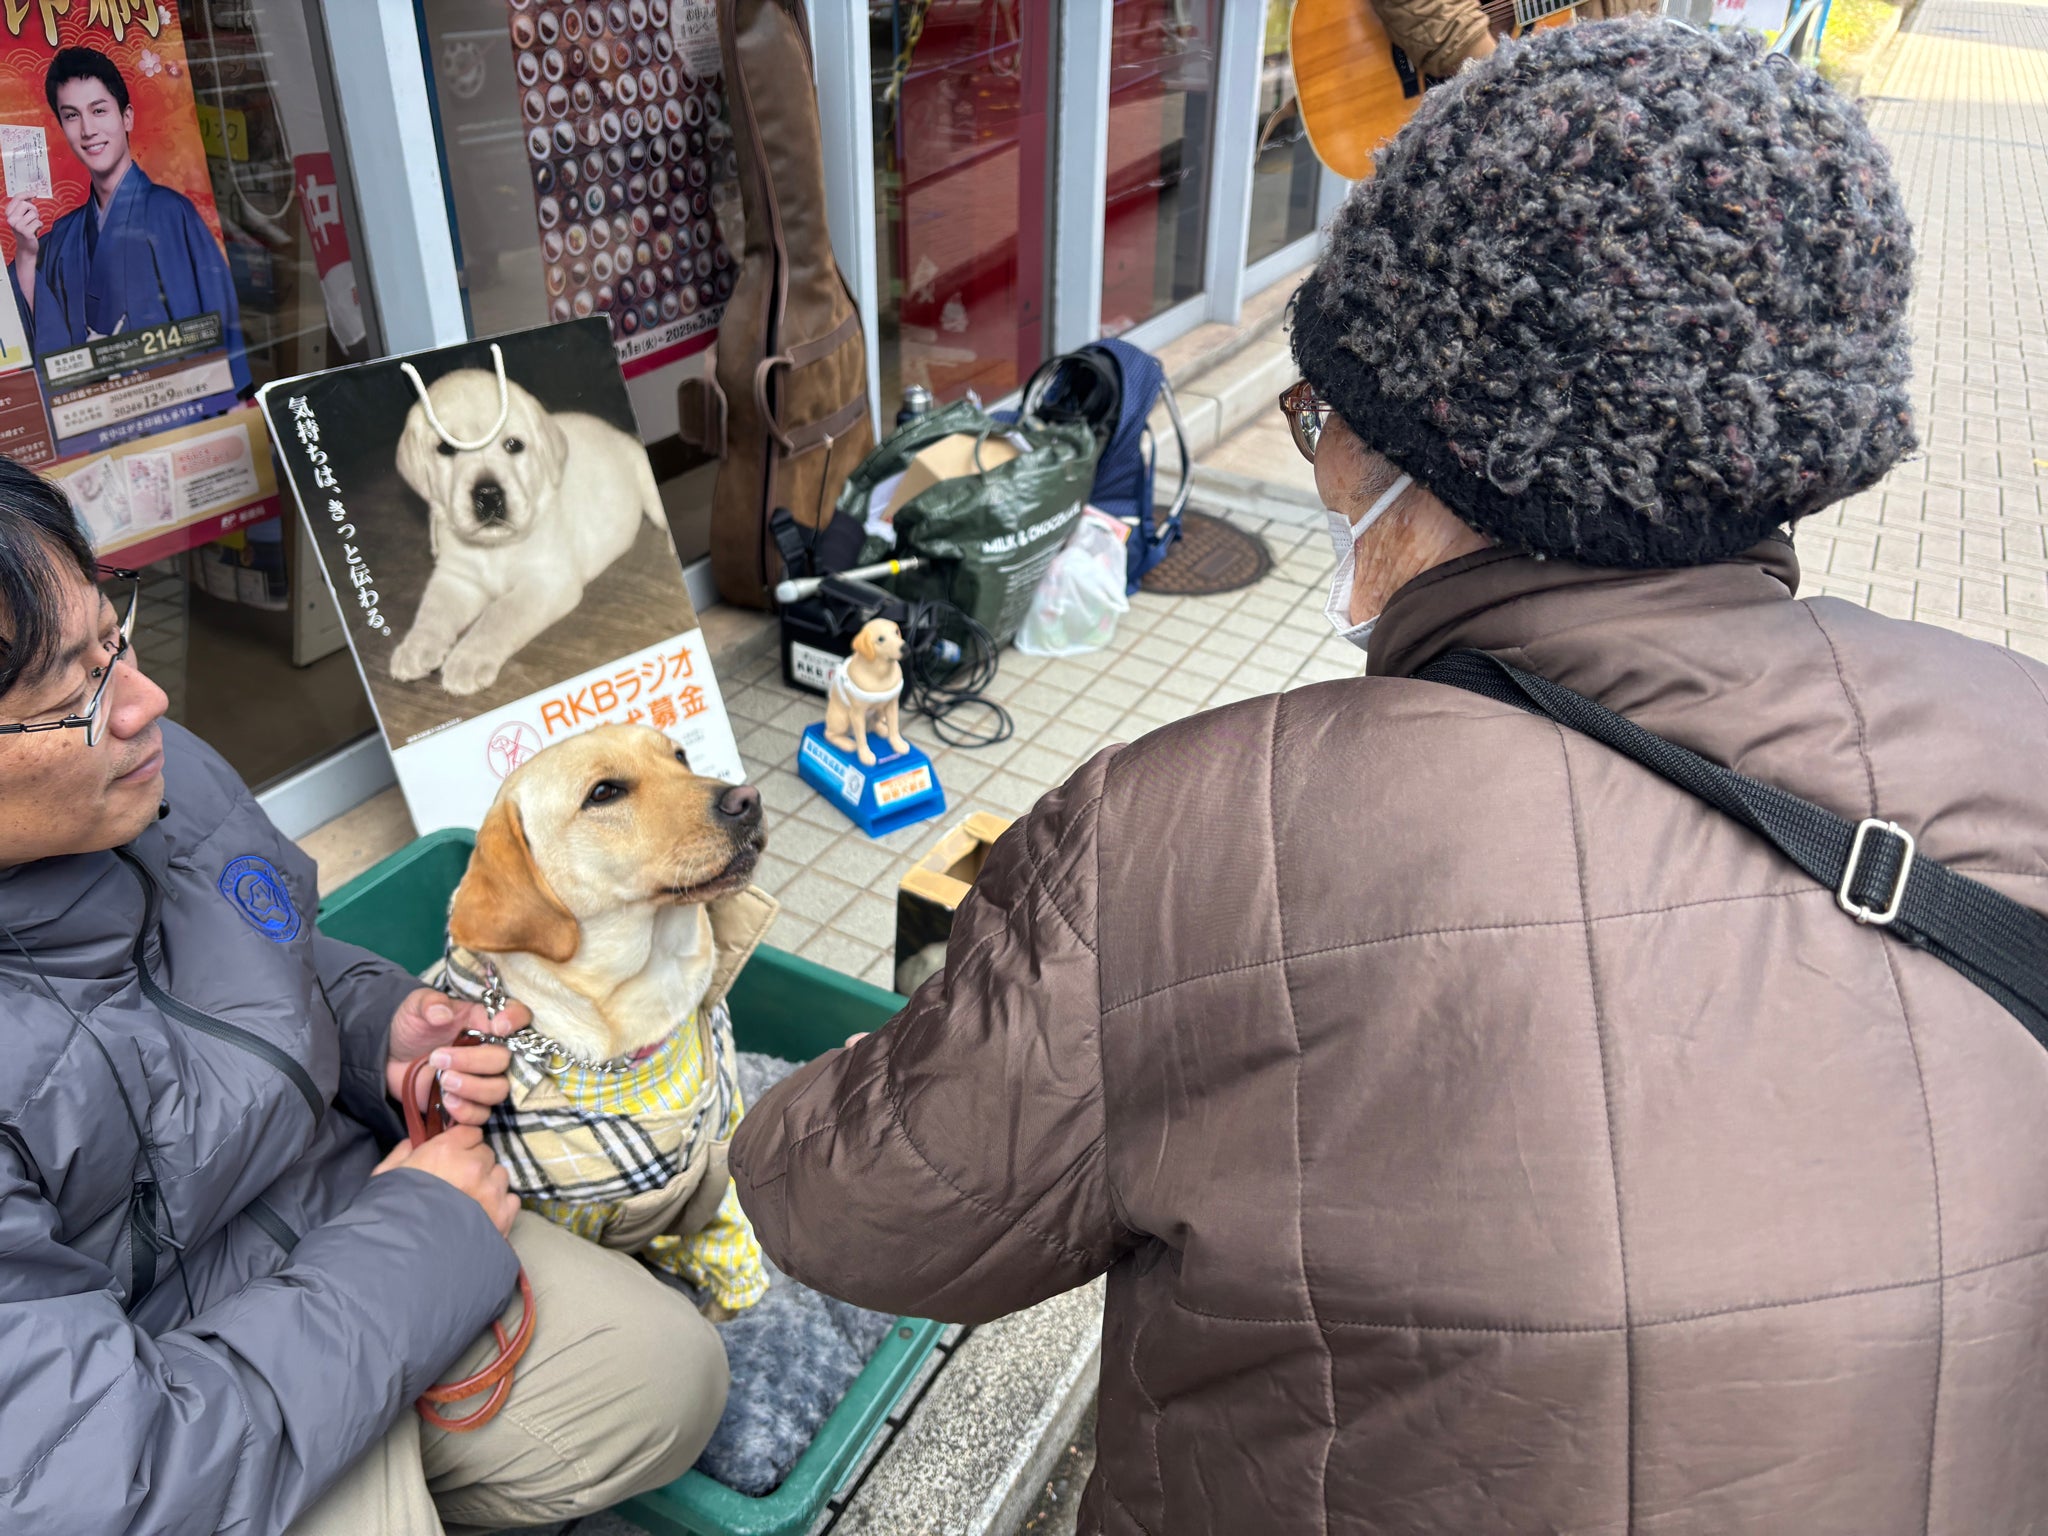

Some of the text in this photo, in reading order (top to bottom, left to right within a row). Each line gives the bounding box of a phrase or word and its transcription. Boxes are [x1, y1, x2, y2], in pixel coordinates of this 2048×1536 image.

[140, 324, 184, 355] 214
[288, 395, 391, 637] 気持ちは、きっと伝わる。
[981, 532, 1019, 554] MILK
[1017, 529, 1029, 548] &
[540, 646, 694, 736] RKBラジオ
